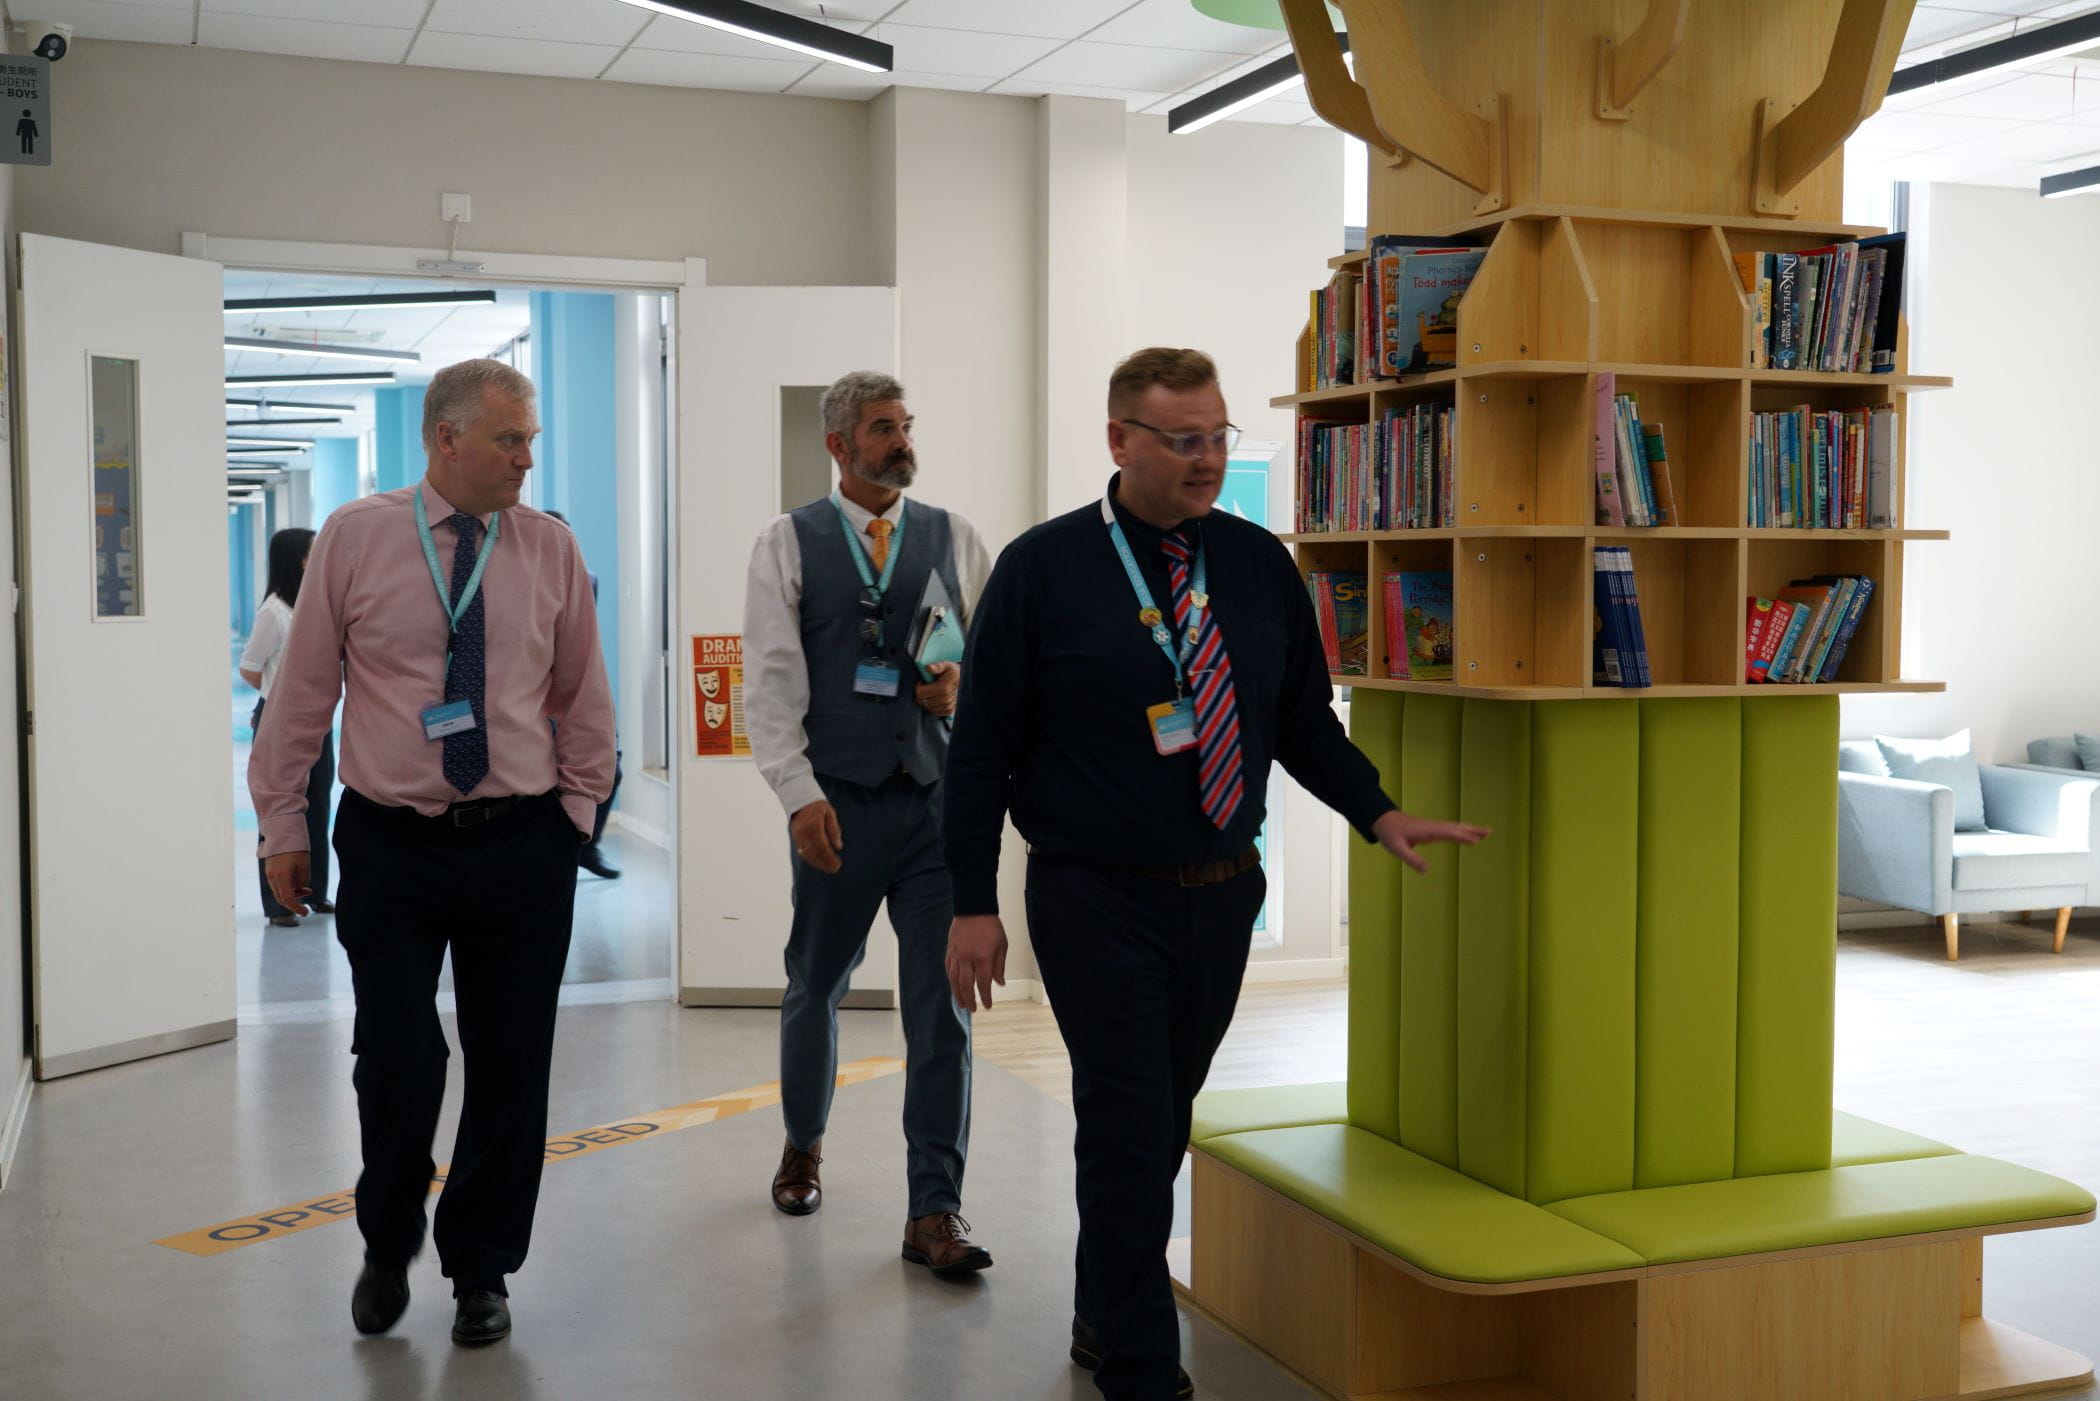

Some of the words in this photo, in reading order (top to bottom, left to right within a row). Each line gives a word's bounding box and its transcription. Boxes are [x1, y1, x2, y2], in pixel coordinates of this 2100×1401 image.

[7, 88, 38, 99] BOYS
[1412, 276, 1437, 288] Toad
[1335, 582, 1367, 601] Sin
[208, 1193, 356, 1241] OPE
[544, 1122, 659, 1157] DED
